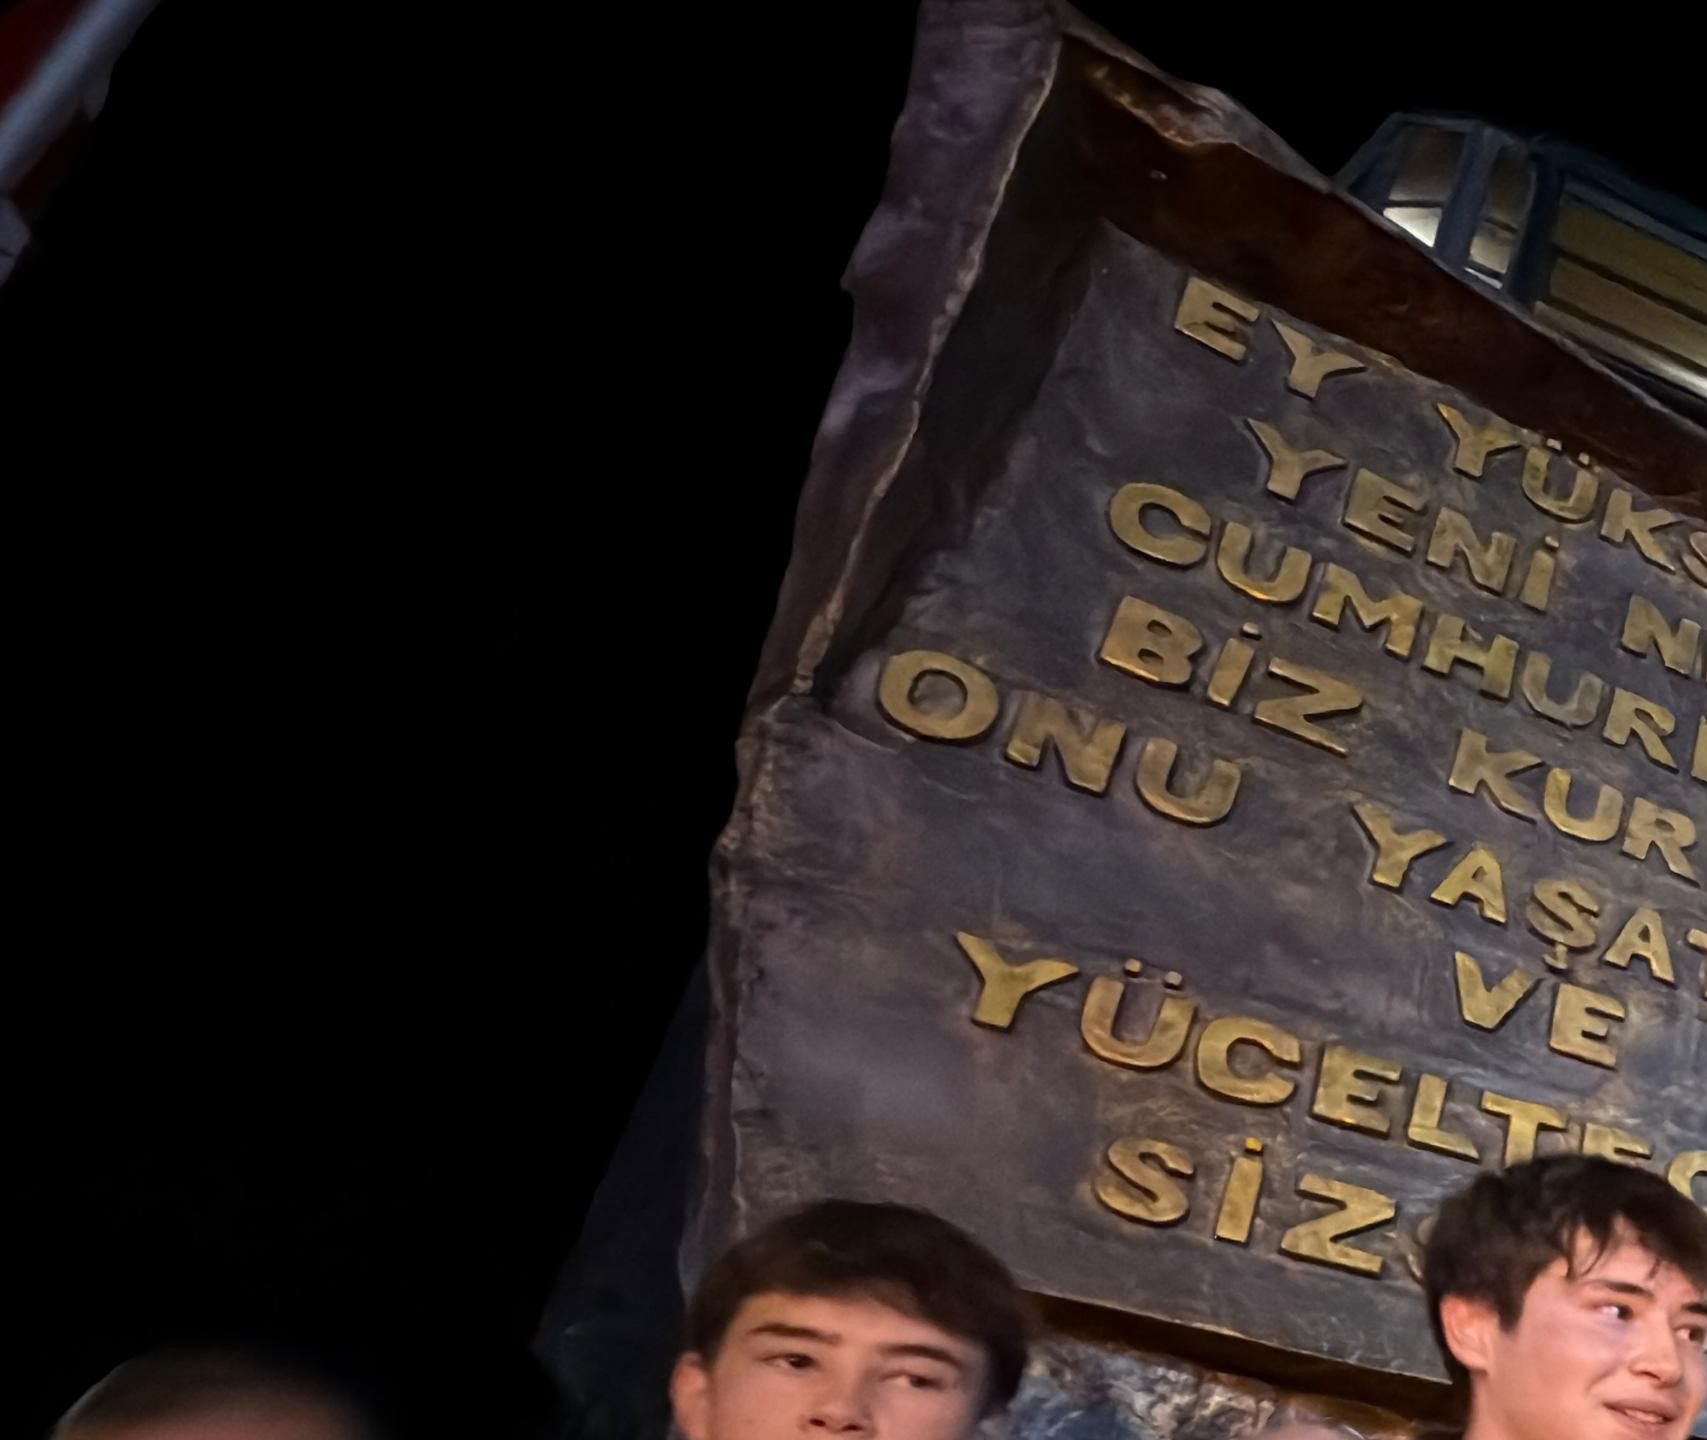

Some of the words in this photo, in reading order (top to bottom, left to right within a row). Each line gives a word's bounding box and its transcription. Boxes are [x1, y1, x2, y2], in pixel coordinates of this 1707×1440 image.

[1174, 276, 1368, 400] EY
[1245, 417, 1560, 614] YENİ
[879, 650, 1242, 828] ONU
[1099, 596, 1364, 757] BİZ
[1455, 951, 1626, 1070] VE
